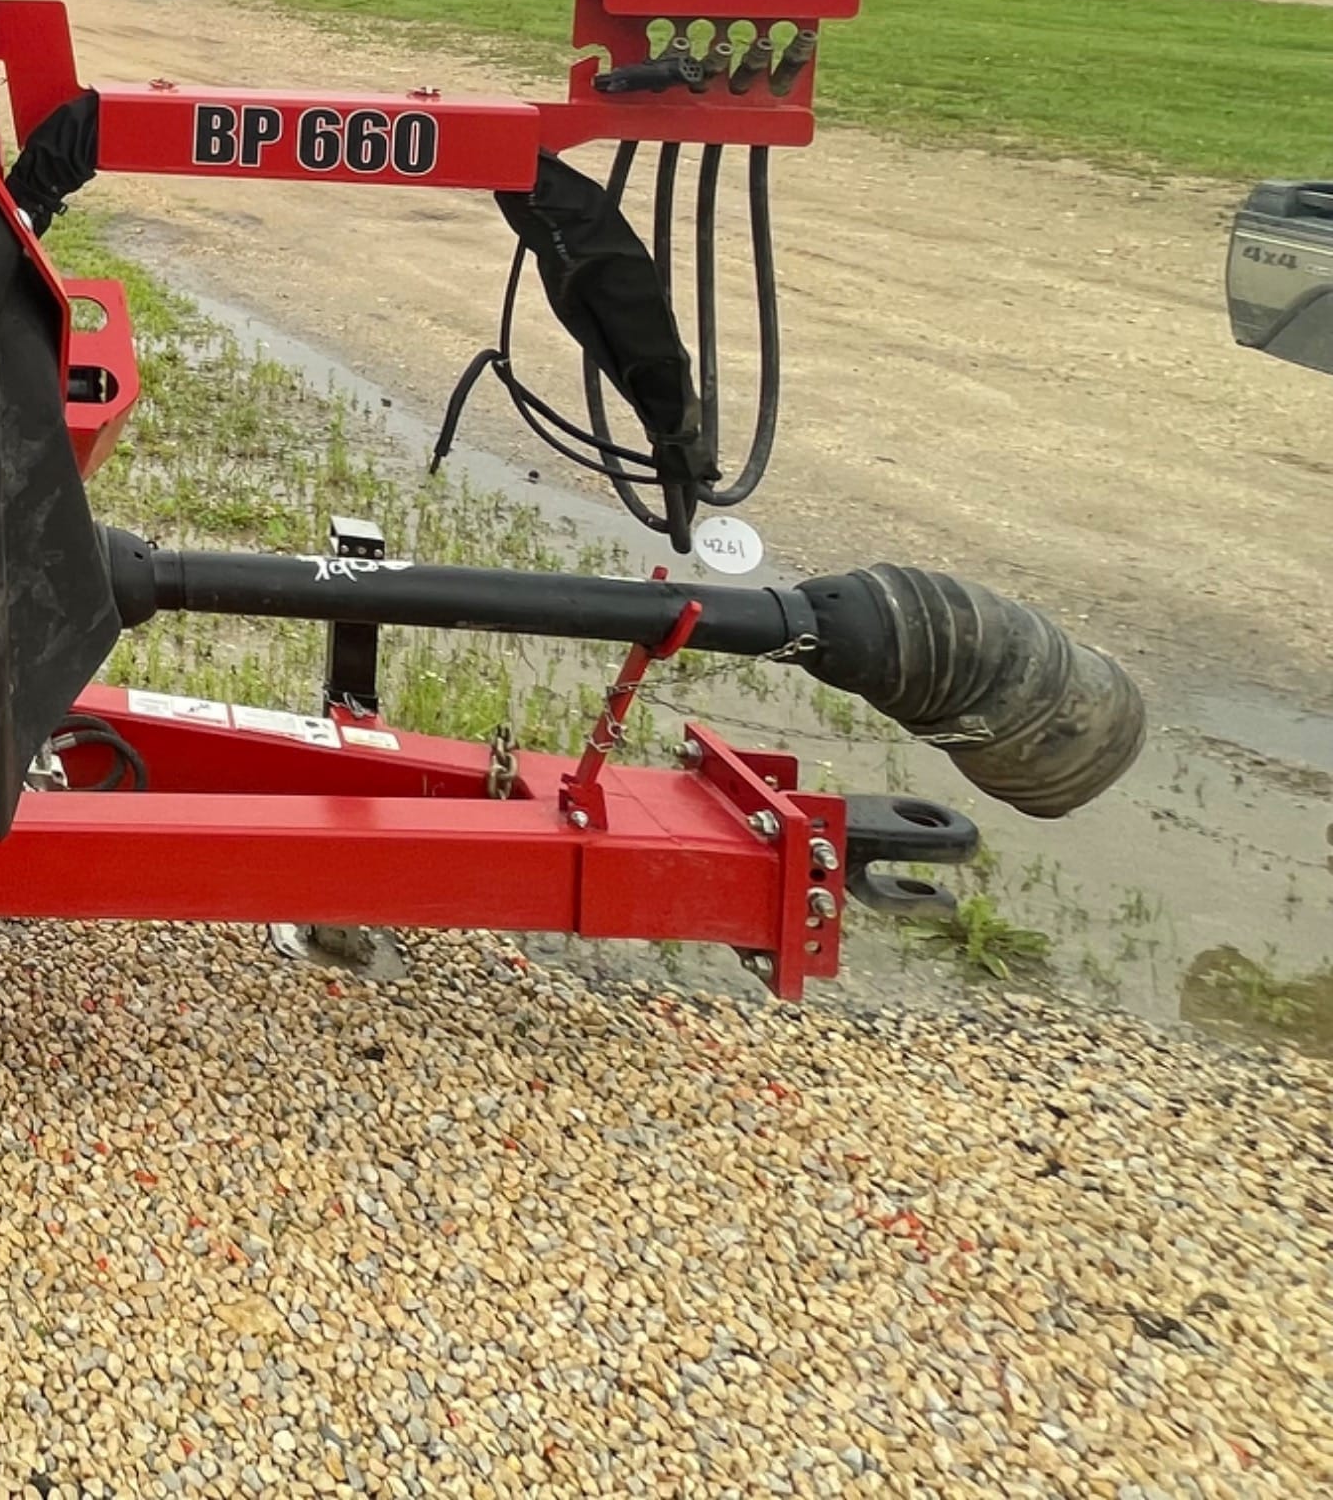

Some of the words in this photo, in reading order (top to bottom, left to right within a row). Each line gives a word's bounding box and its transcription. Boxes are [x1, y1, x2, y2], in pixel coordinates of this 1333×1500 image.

[191, 103, 283, 168] BP
[296, 106, 439, 177] 660
[703, 537, 746, 559] 4261
